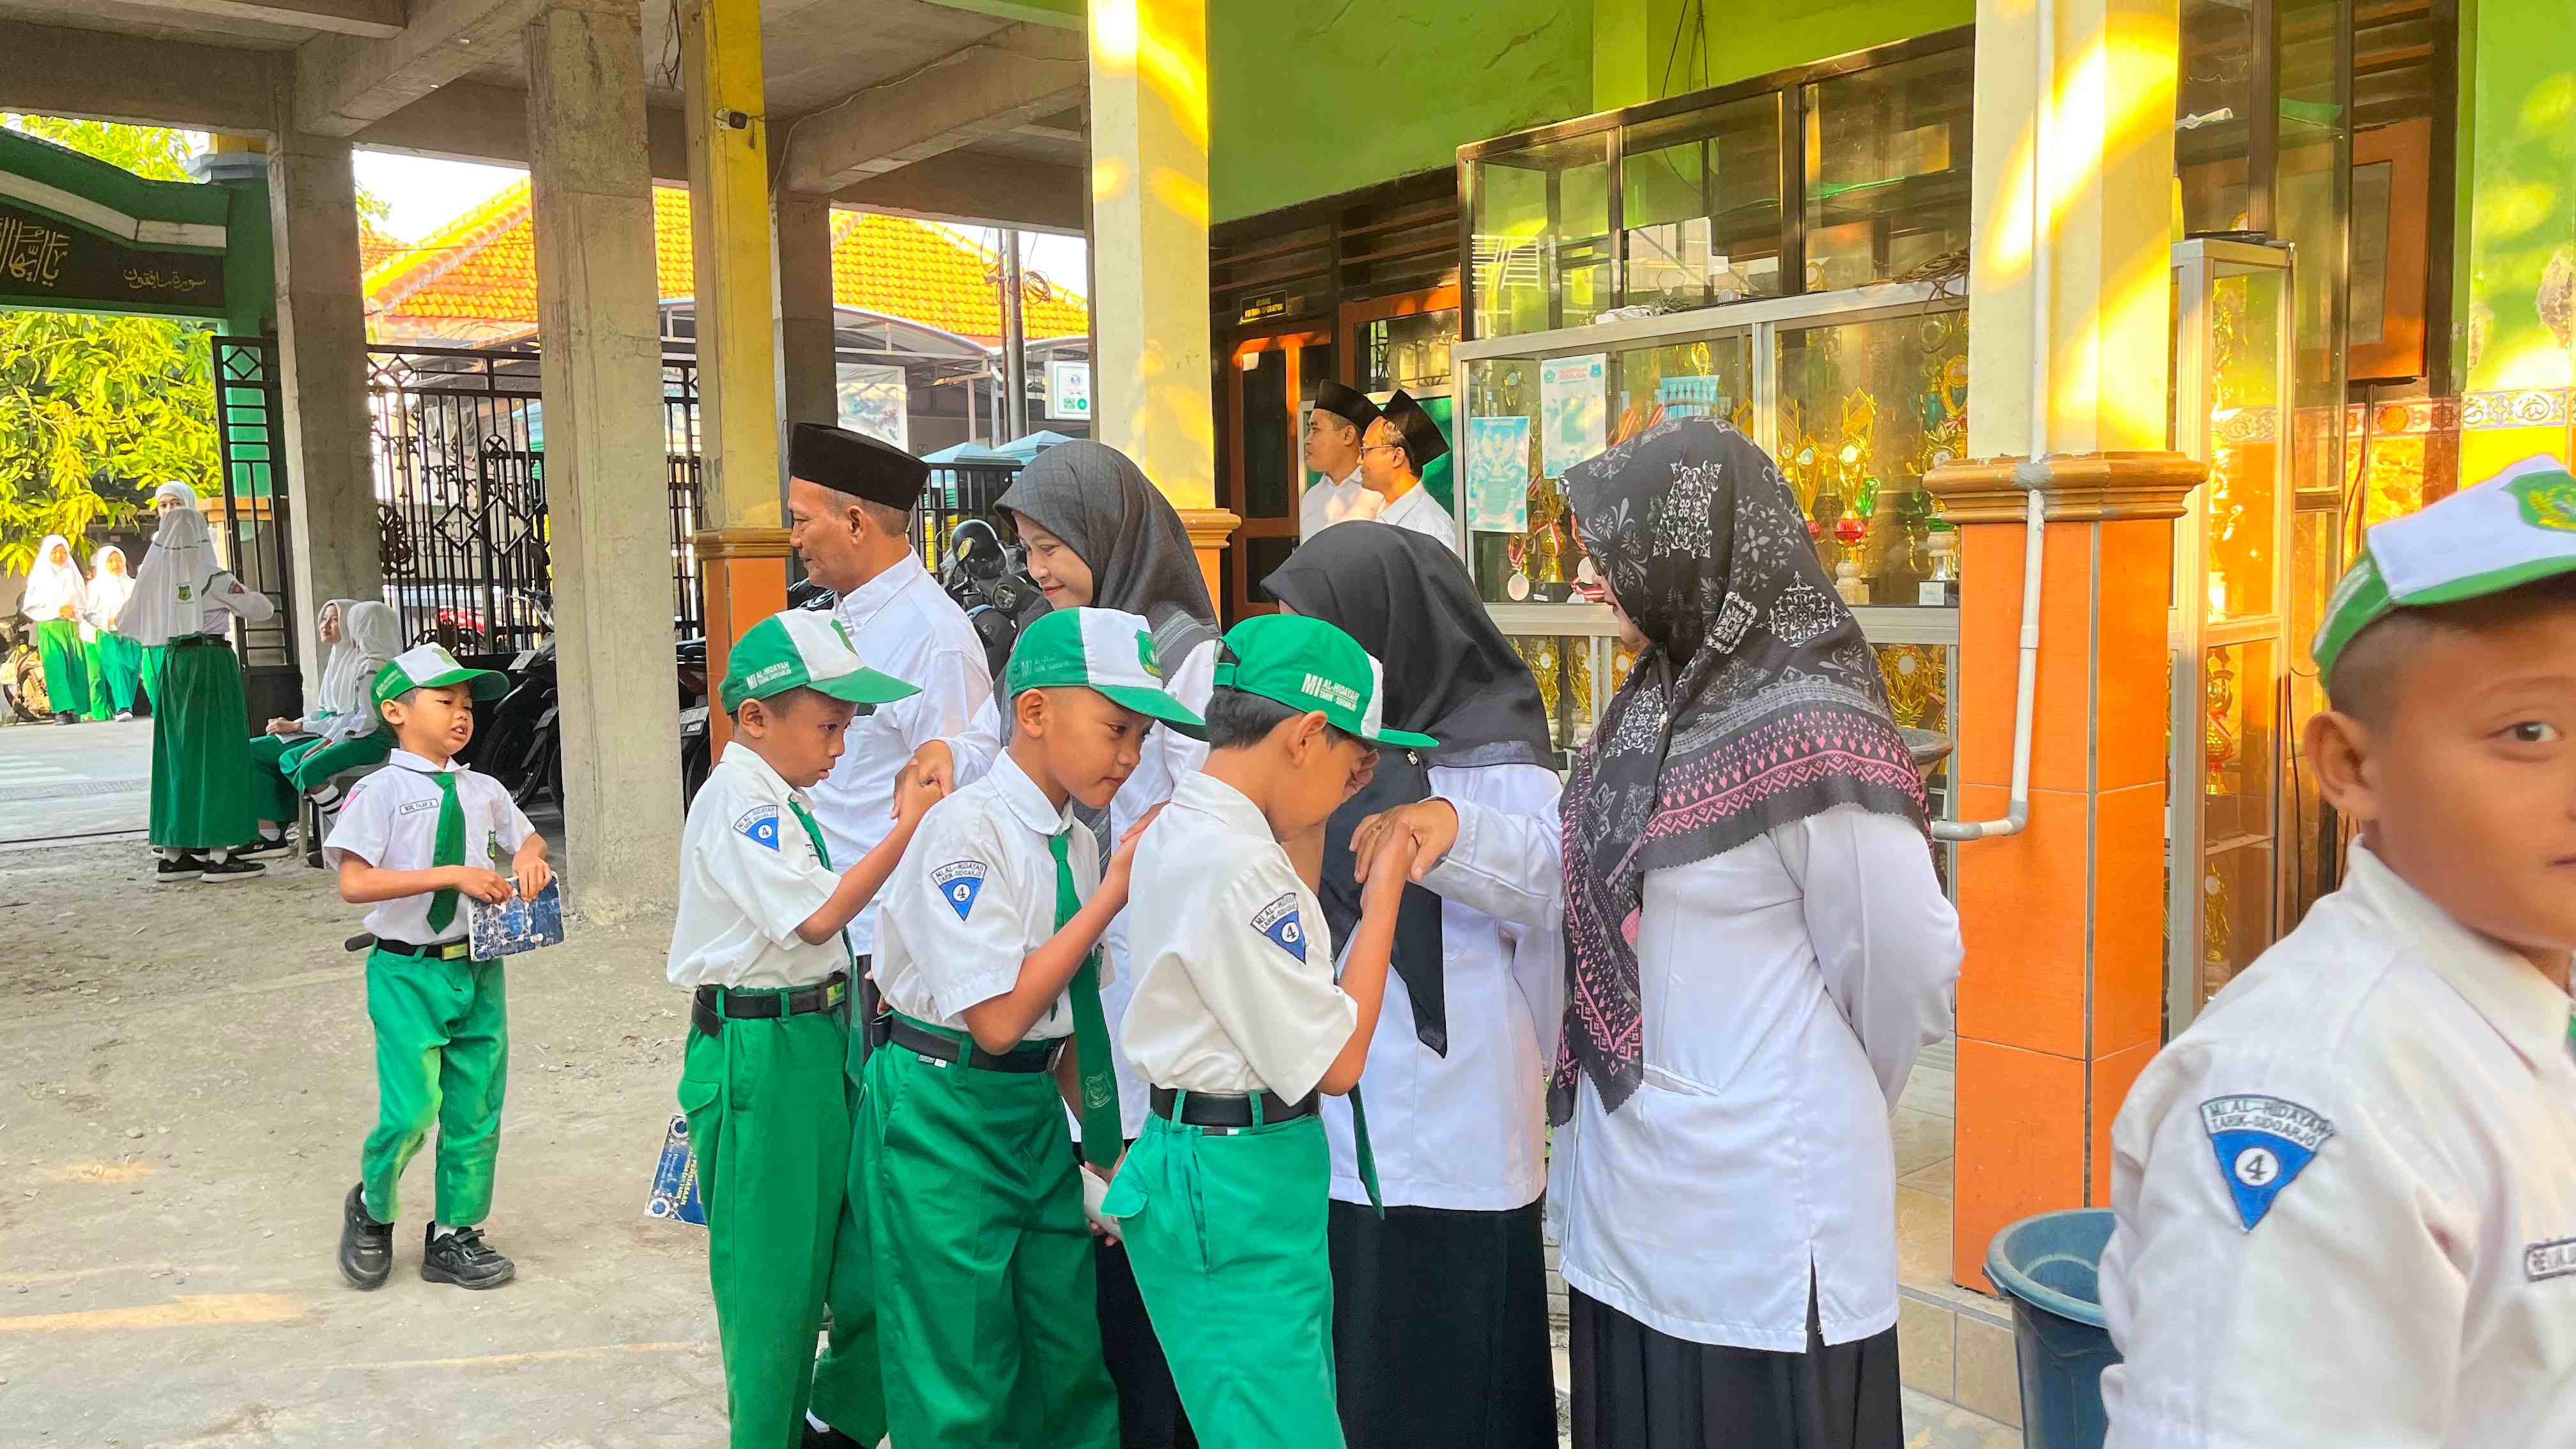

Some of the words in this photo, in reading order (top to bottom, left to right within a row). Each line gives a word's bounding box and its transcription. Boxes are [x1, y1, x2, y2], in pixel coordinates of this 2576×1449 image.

[746, 674, 758, 690] MI
[1301, 673, 1323, 696] MI
[1322, 678, 1360, 702] AL-HIDAYAH
[762, 827, 770, 836] 4
[957, 886, 966, 899] 4
[1287, 925, 1297, 939] 4
[2245, 1154, 2267, 1181] 4
